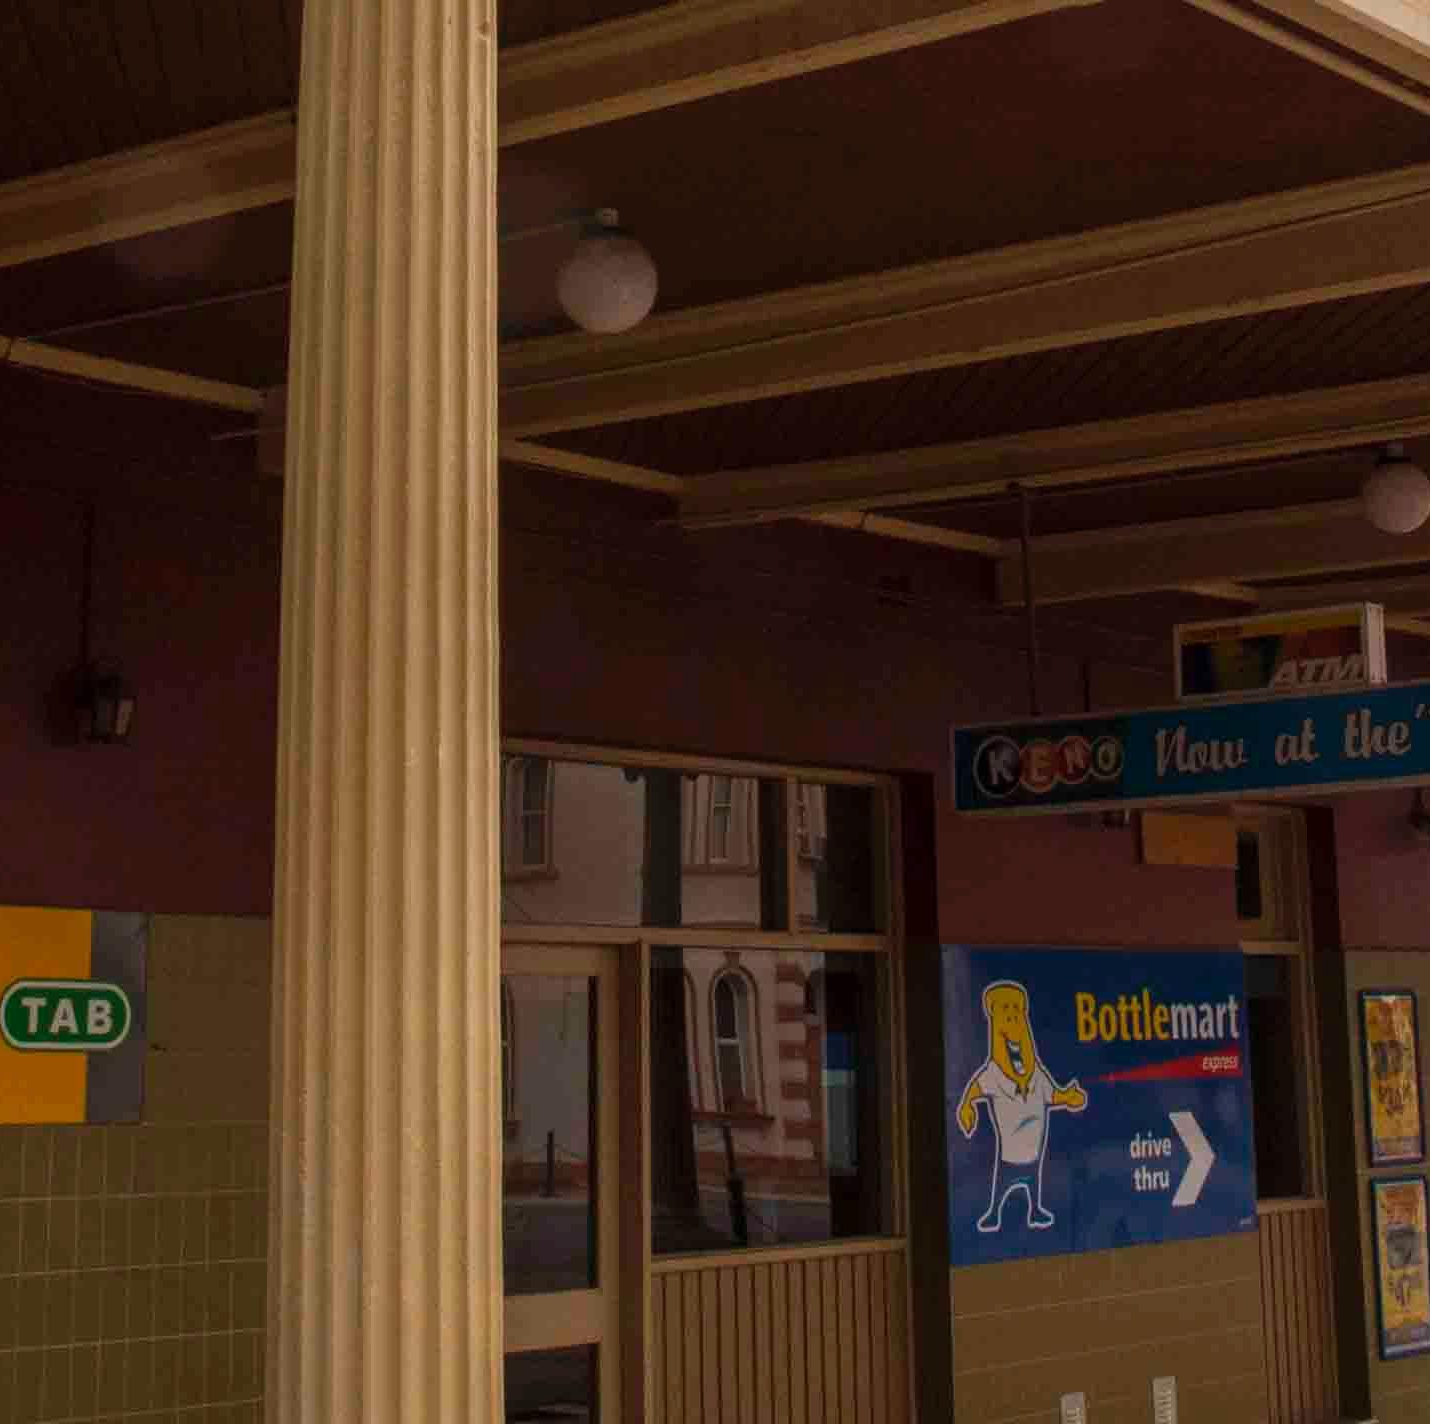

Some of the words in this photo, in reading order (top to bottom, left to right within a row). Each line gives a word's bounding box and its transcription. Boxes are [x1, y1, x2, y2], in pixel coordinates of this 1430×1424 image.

[1273, 653, 1365, 682] ATM
[984, 736, 1118, 788] KENO
[1155, 724, 1249, 784] Now
[1275, 719, 1319, 765] at
[1344, 708, 1412, 759] the
[21, 996, 113, 1035] TAB
[1074, 988, 1241, 1041] Bottlemart
[1130, 1131, 1171, 1158] drive
[1134, 1165, 1170, 1191] thru
